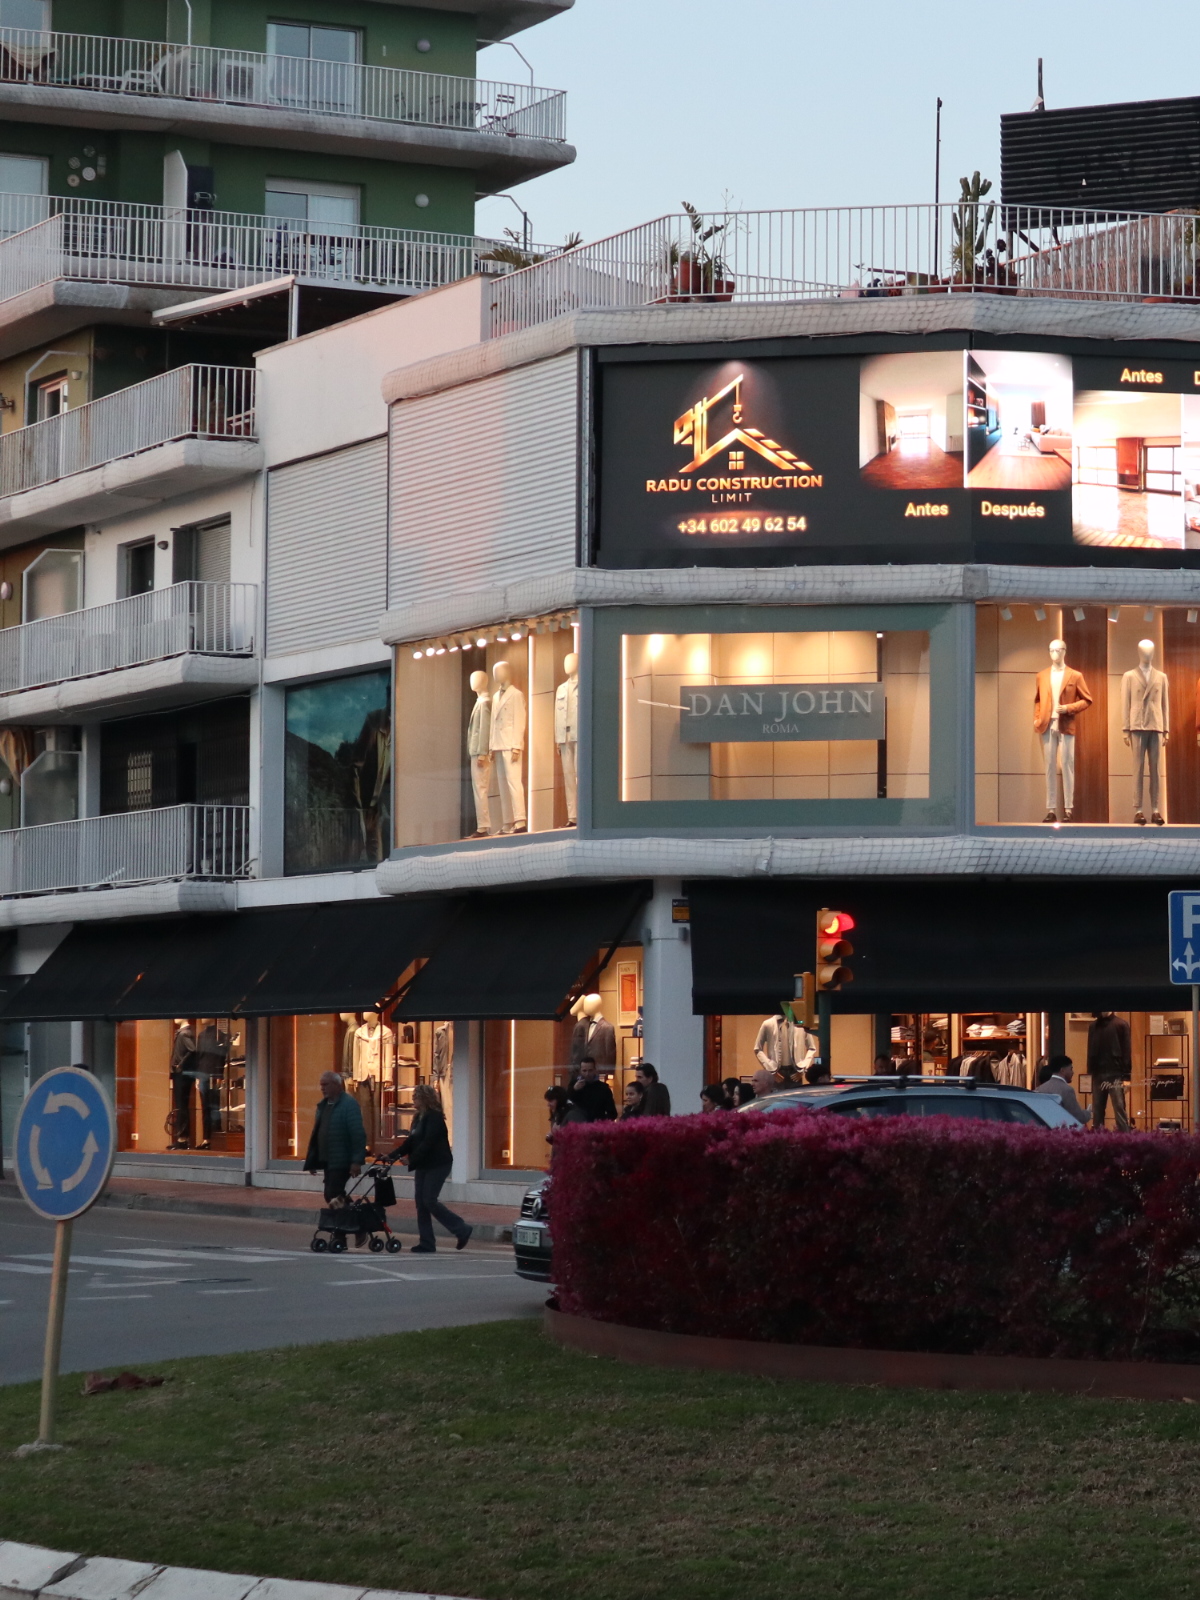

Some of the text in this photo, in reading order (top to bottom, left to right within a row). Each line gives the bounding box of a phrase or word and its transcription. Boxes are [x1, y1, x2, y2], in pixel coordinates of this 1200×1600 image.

[1120, 368, 1163, 384] Antes
[646, 475, 823, 493] RADU CONSTRUCTION
[711, 493, 752, 503] LIMIT
[905, 501, 1045, 520] Antes Después
[678, 516, 807, 534] +34 602 49 62 54
[688, 690, 875, 723] DAN JOHN
[762, 723, 800, 734] ROMA
